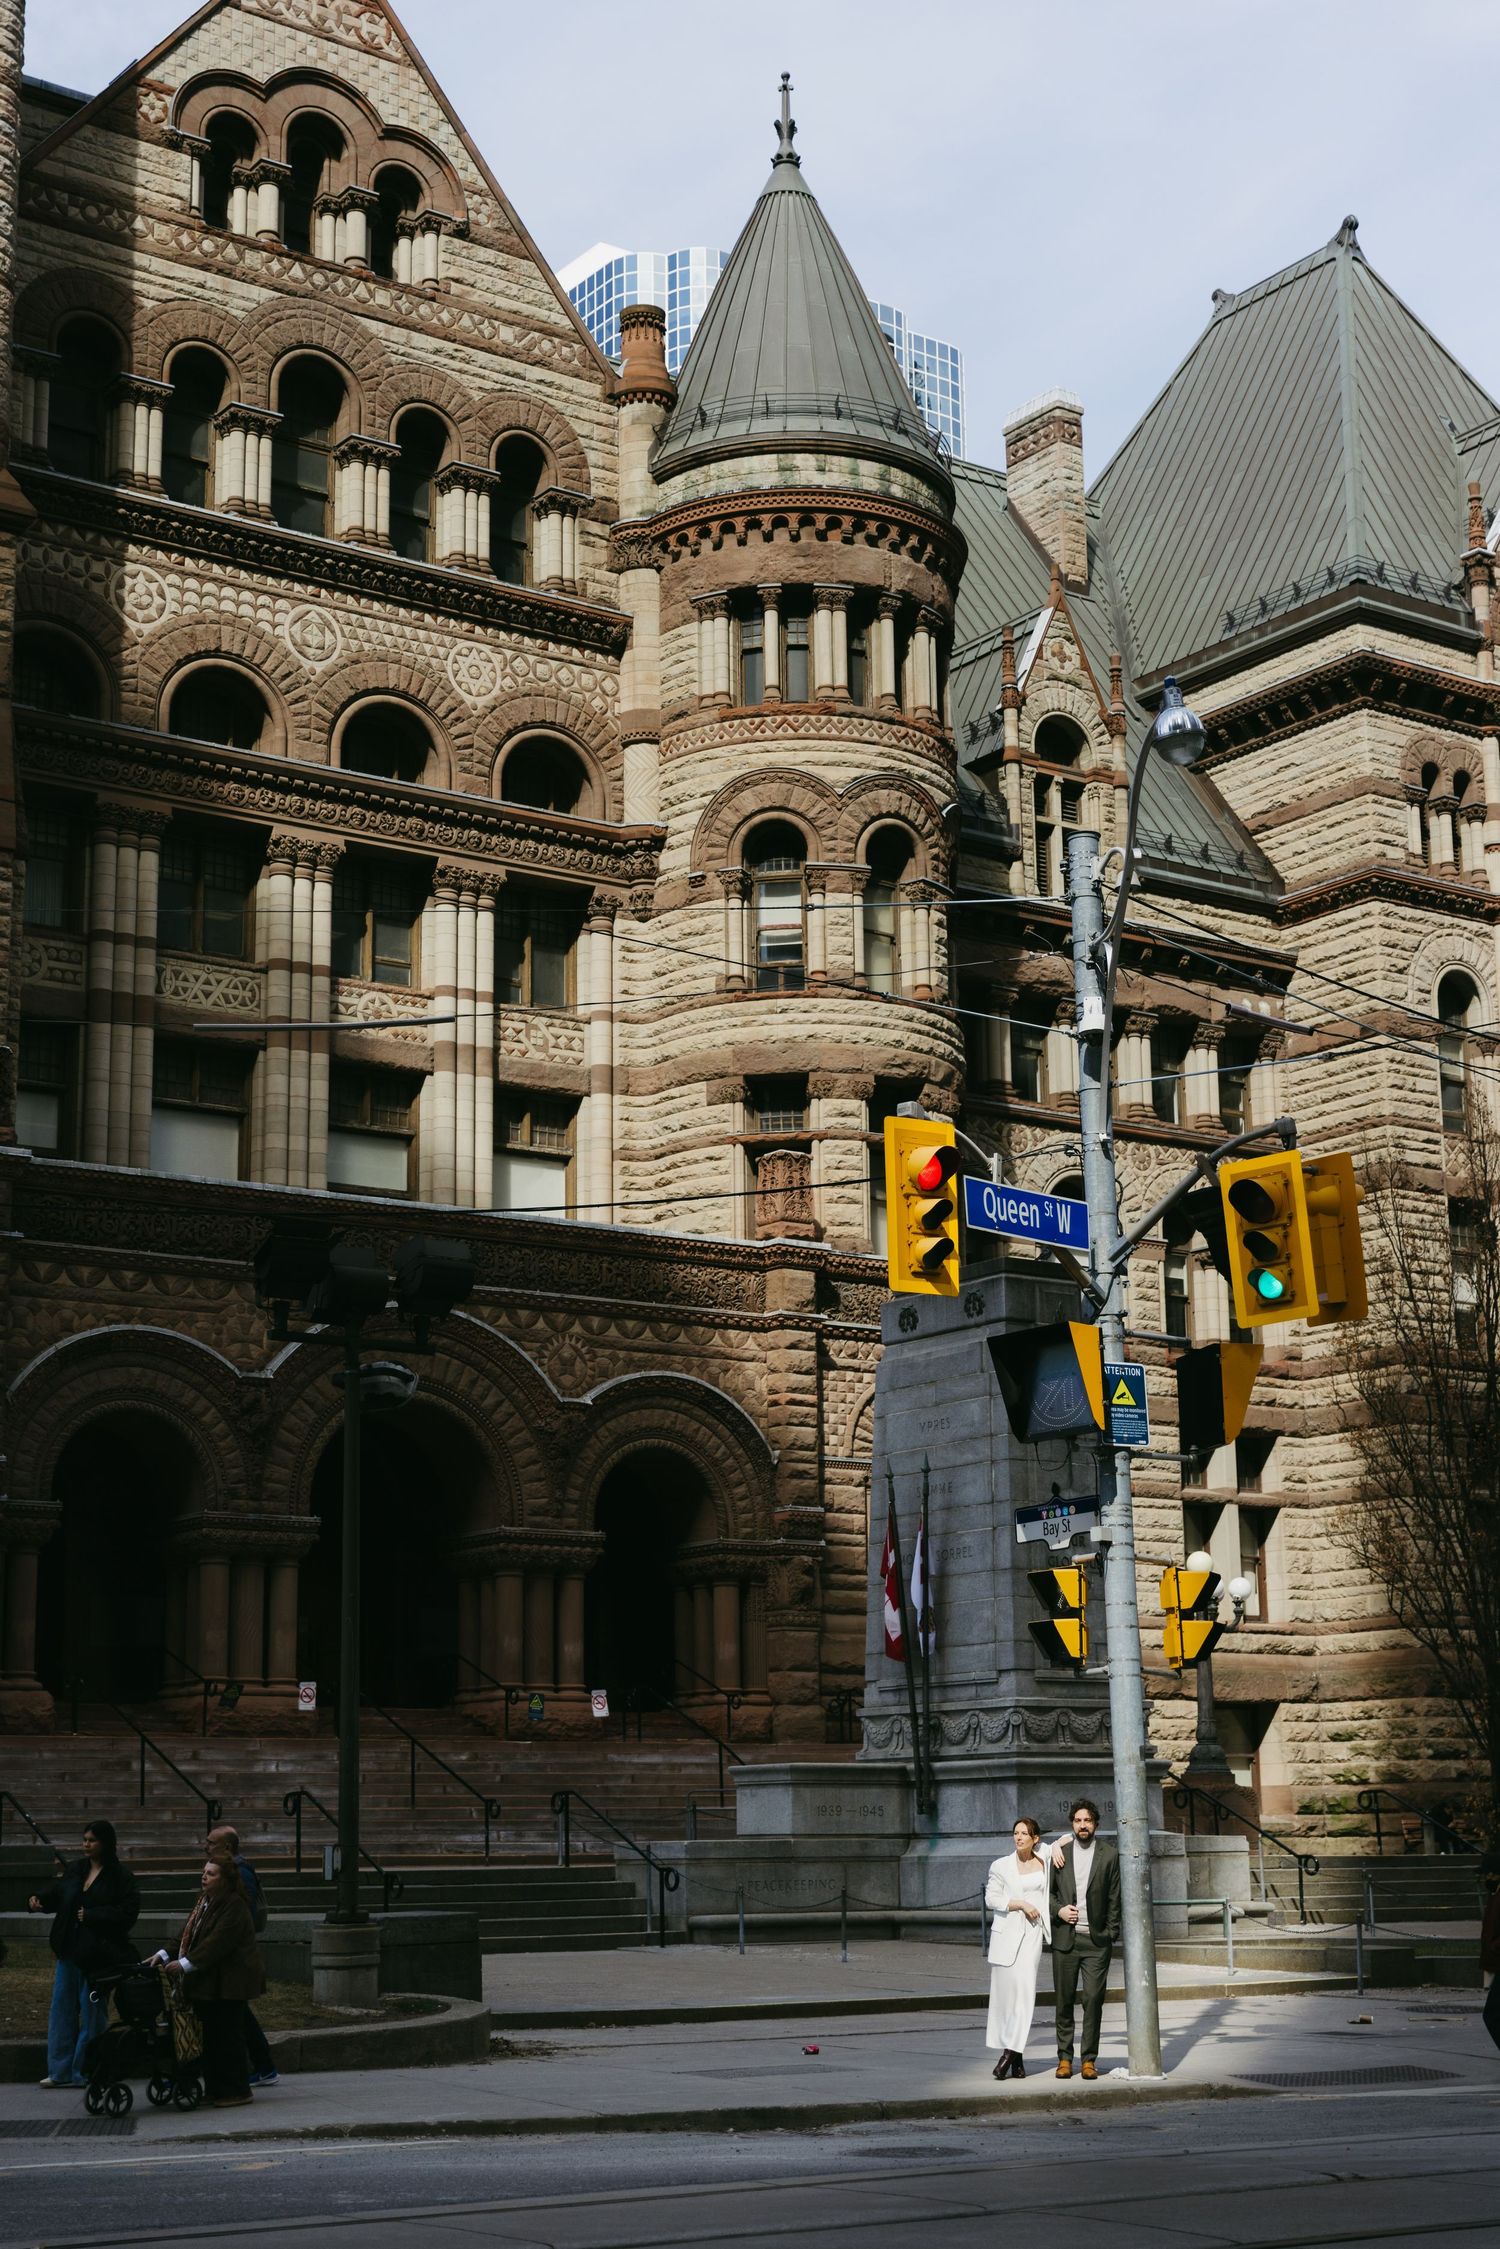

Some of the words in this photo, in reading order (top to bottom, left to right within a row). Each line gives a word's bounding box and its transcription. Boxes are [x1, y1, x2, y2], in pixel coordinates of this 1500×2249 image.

[983, 1187, 1040, 1228] Queen
[1044, 1201, 1053, 1217] St
[1057, 1203, 1071, 1234] W
[919, 1417, 951, 1432] YPRES
[917, 1482, 953, 1498] SMME
[1043, 1521, 1060, 1538] Bay
[1062, 1518, 1071, 1533] St
[935, 1545, 973, 1562] SORREL
[817, 1805, 842, 1817] 1939
[859, 1805, 885, 1817] 1945
[747, 1879, 836, 1892] PEACEKEEPING
